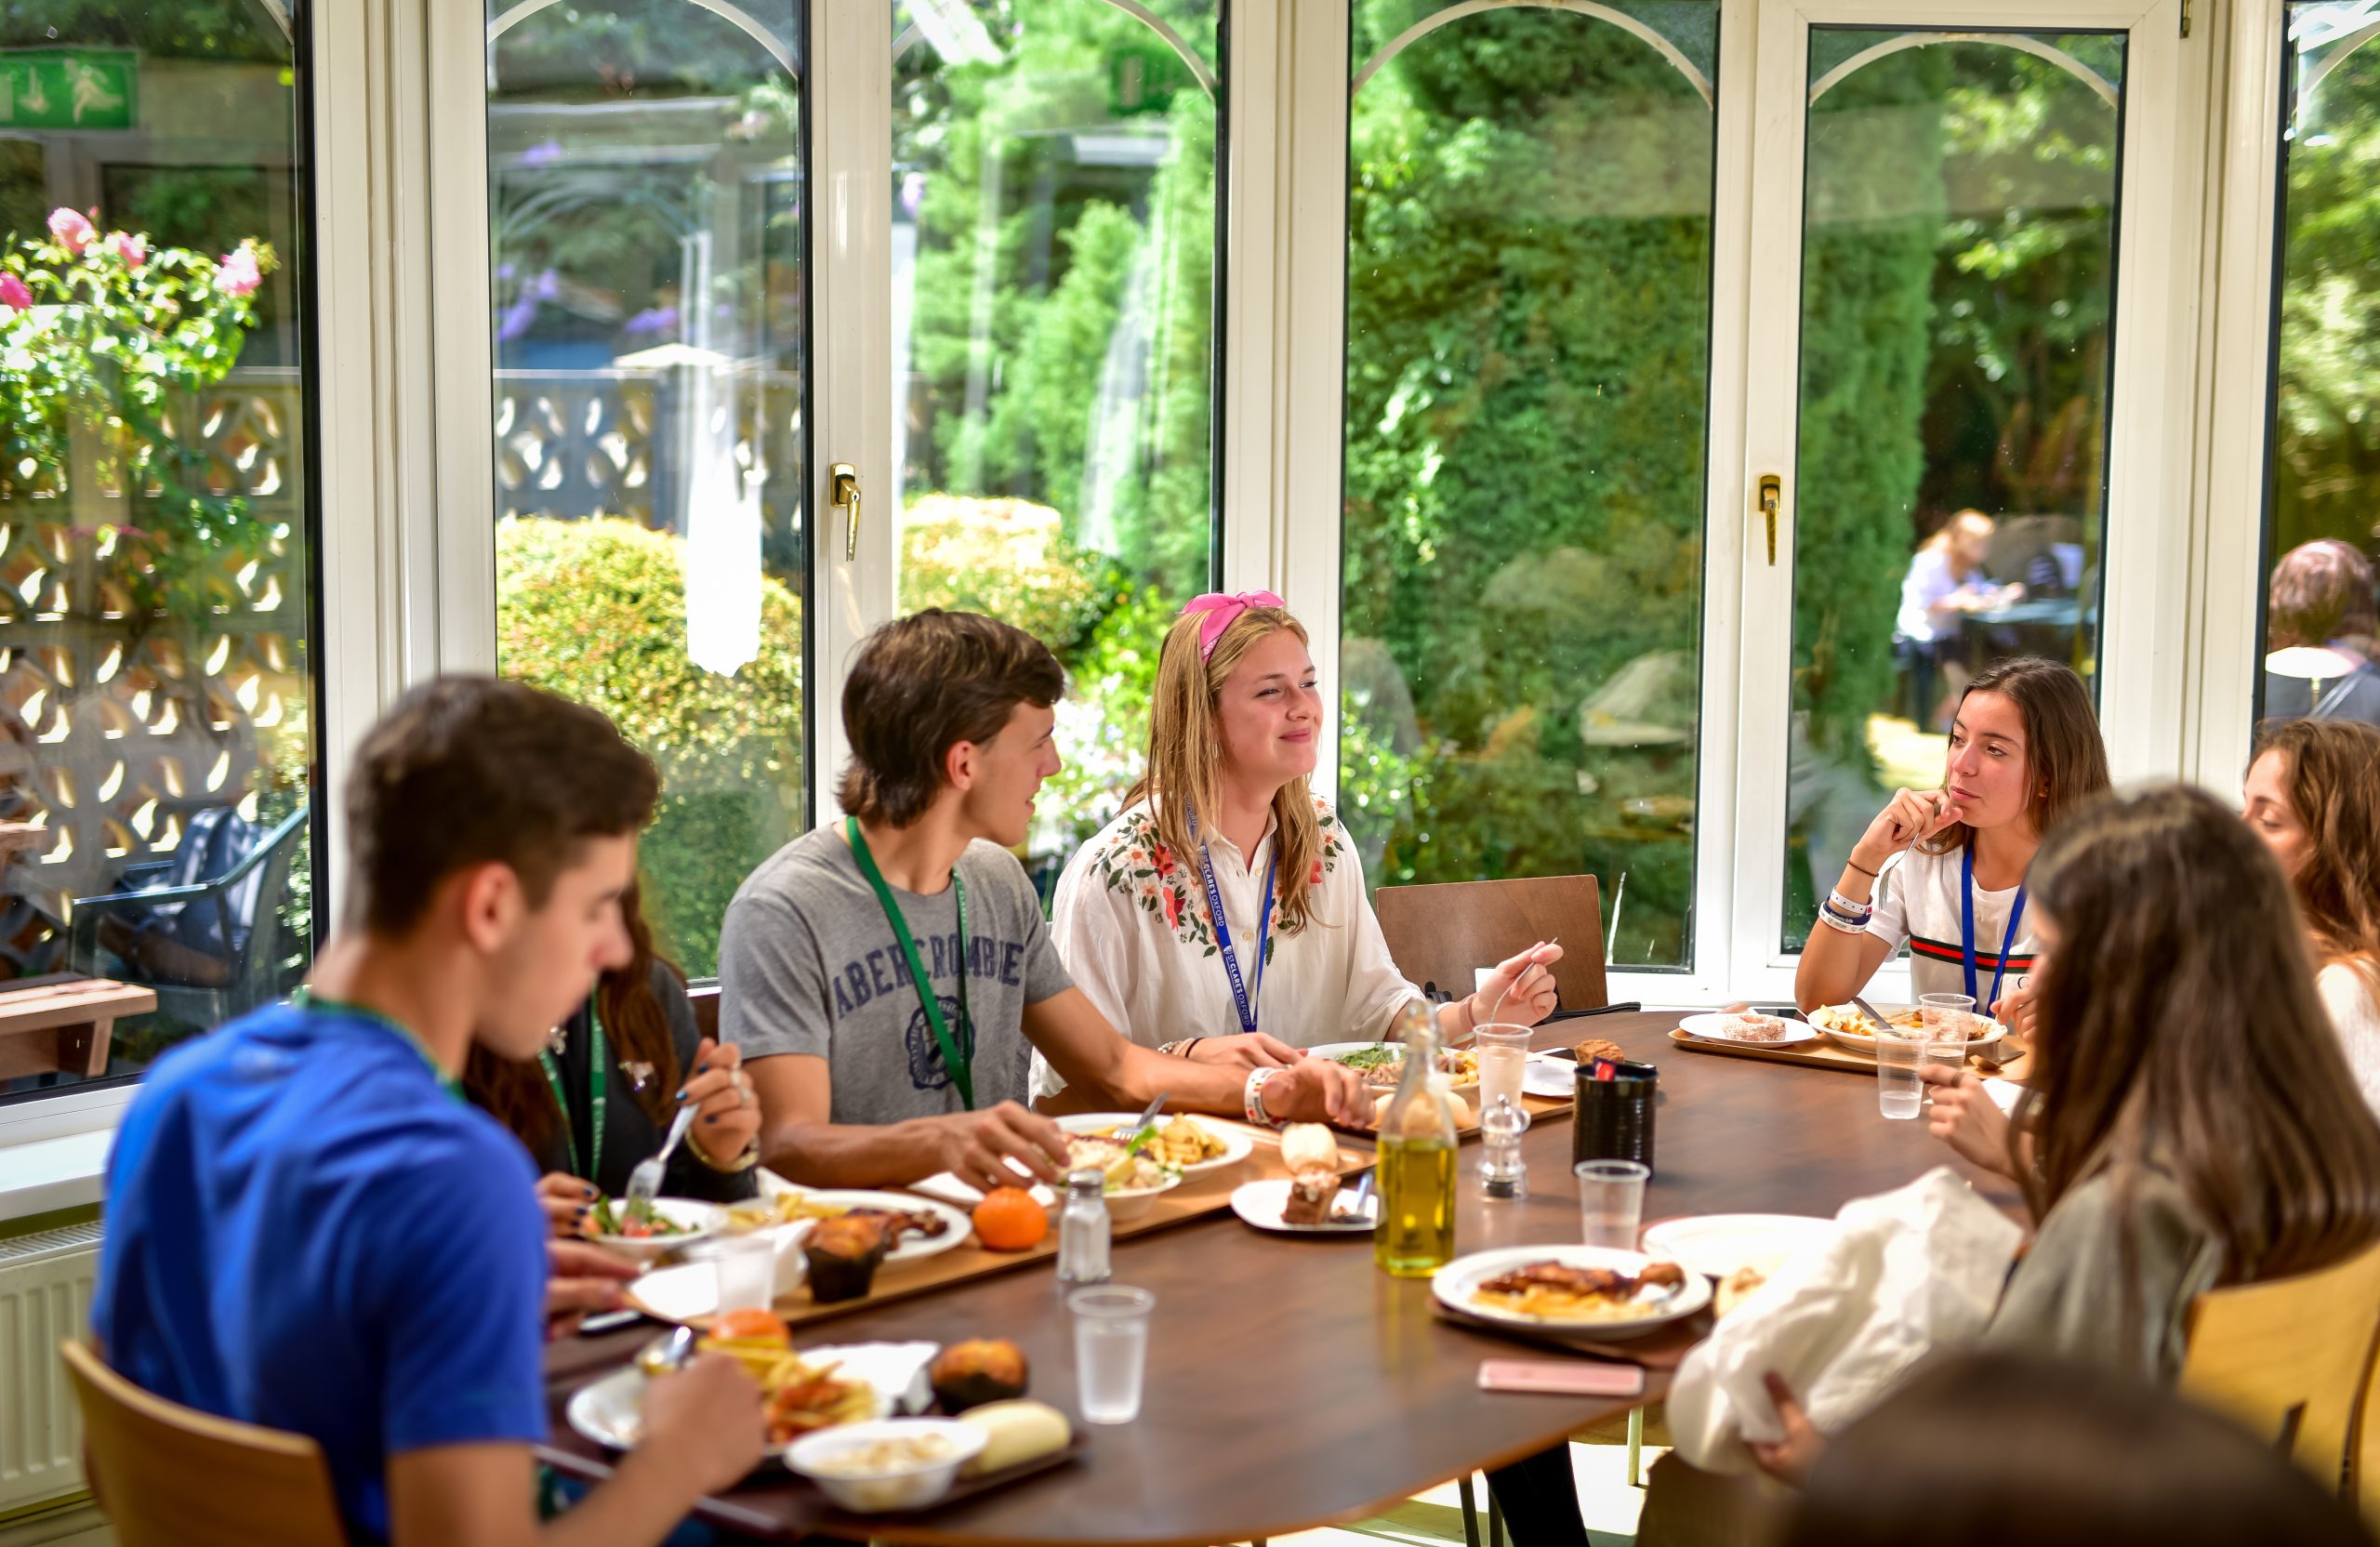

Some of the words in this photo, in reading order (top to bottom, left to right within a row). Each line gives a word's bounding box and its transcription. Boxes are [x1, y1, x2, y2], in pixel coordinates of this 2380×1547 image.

[1211, 895, 1224, 927] OXFORD
[1227, 954, 1235, 962] ST
[833, 932, 1025, 1020] ABERROMBIE
[1230, 963, 1244, 993] CLARE'S
[1237, 994, 1250, 1026] OXFORD
